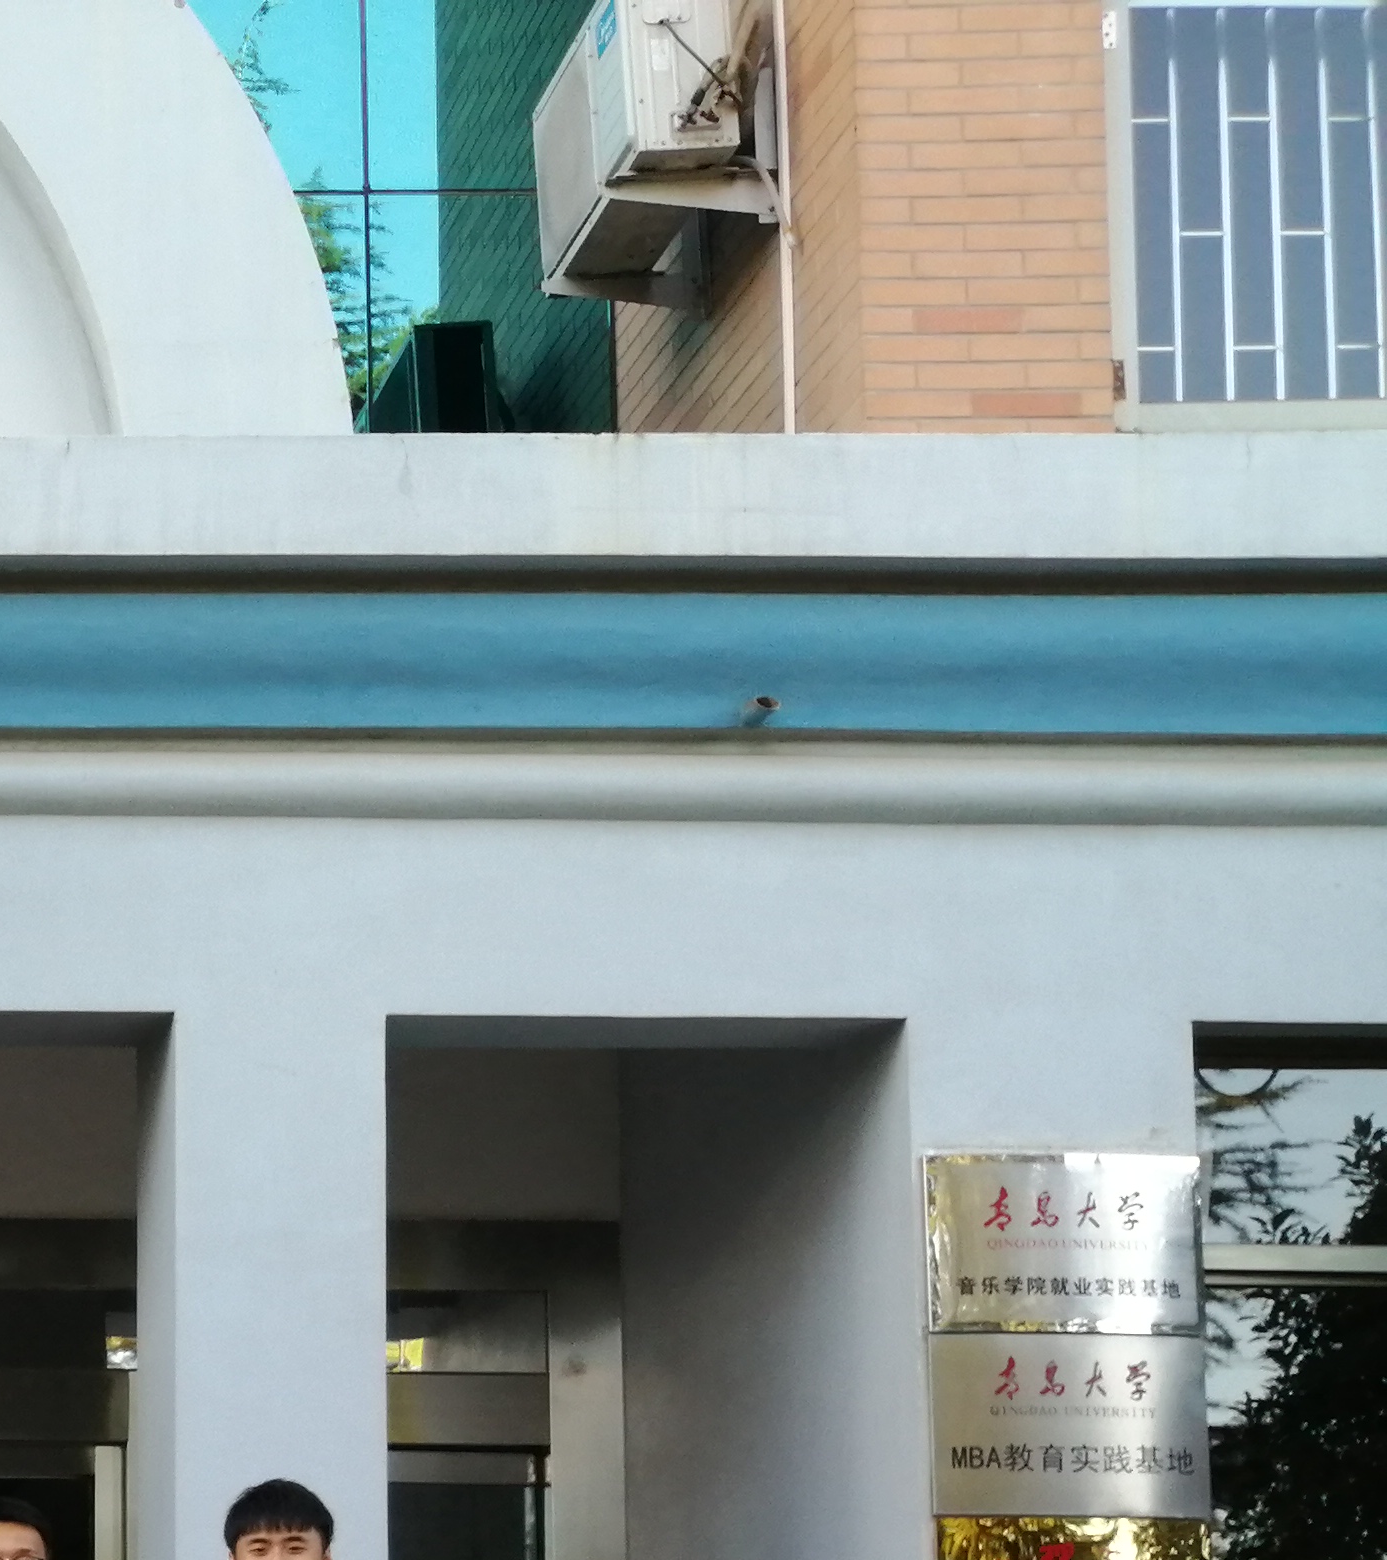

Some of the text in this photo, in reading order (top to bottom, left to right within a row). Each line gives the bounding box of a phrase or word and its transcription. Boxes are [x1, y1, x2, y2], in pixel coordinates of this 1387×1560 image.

[984, 1186, 1144, 1231] 青岛大学
[958, 1276, 1181, 1299] 音乐学院就业实践基地
[994, 1355, 1151, 1401] 青岛大学
[951, 1443, 1195, 1476] MBA教育实践基地
